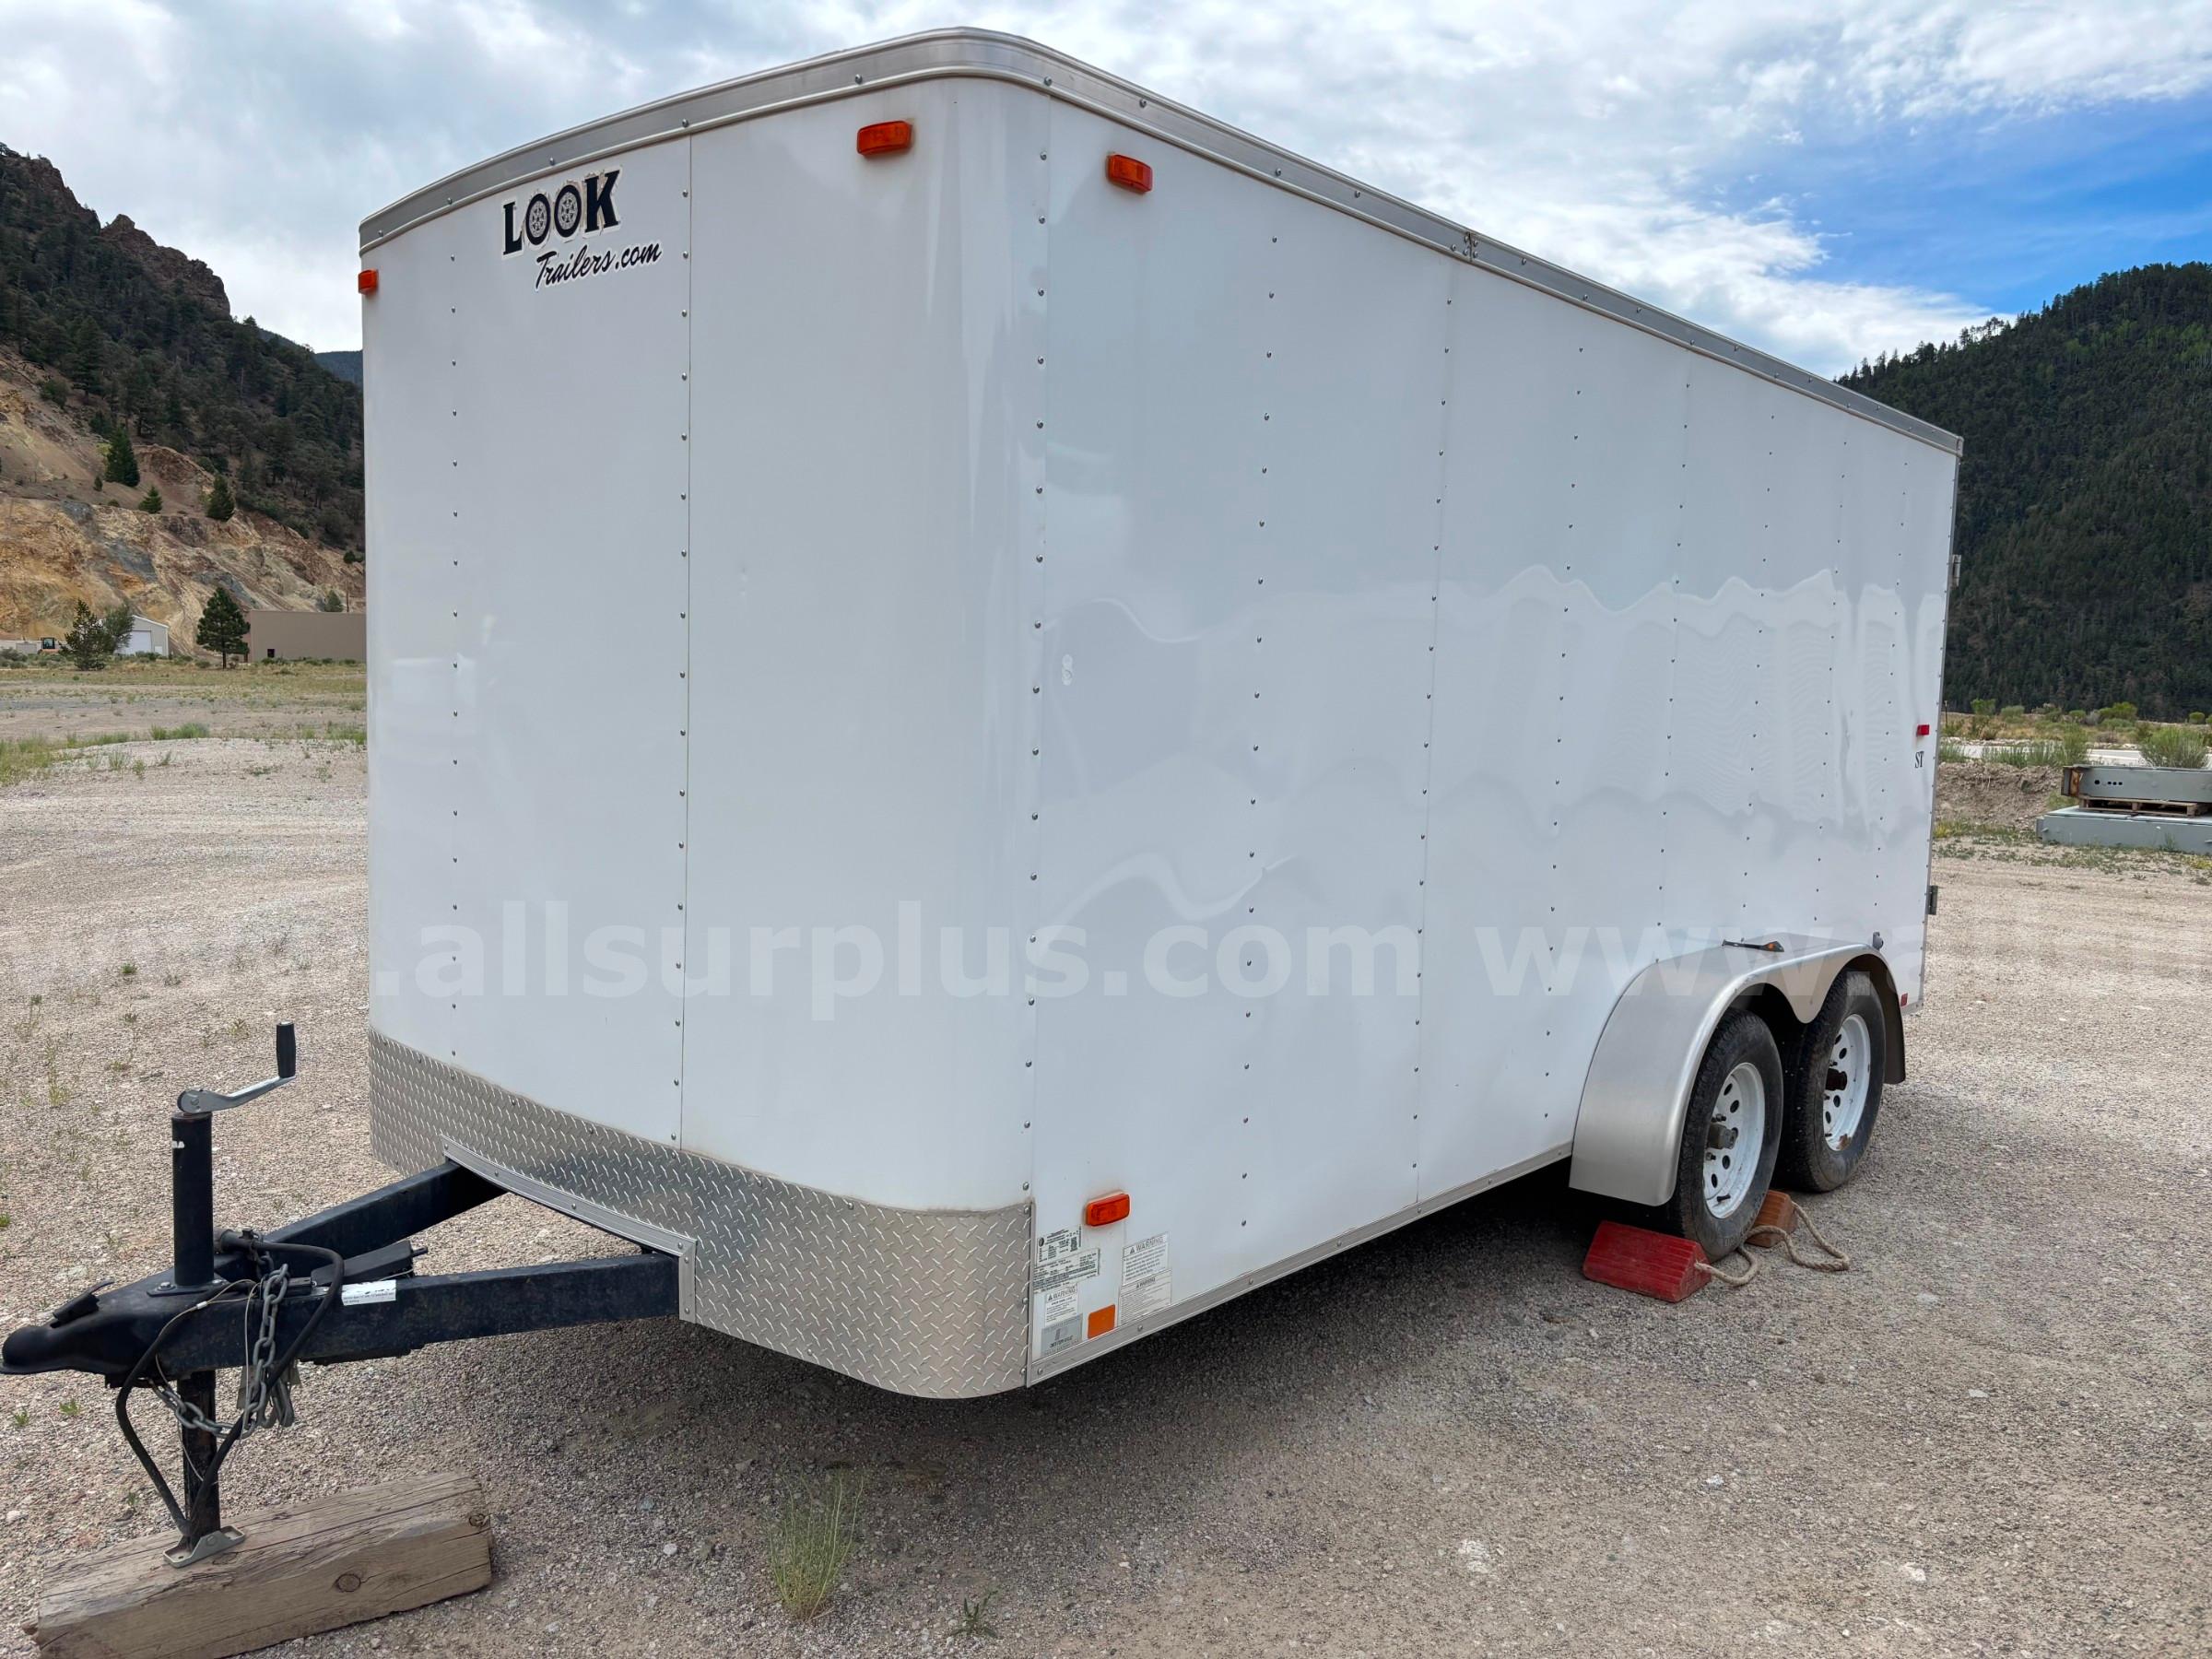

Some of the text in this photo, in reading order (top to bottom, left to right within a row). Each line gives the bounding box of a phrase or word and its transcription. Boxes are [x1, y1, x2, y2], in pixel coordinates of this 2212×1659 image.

[502, 170, 621, 256] LOOK
[535, 242, 663, 289] Trailers.com
[1914, 750, 1924, 768] ST
[1135, 1236, 1164, 1252] WARNING
